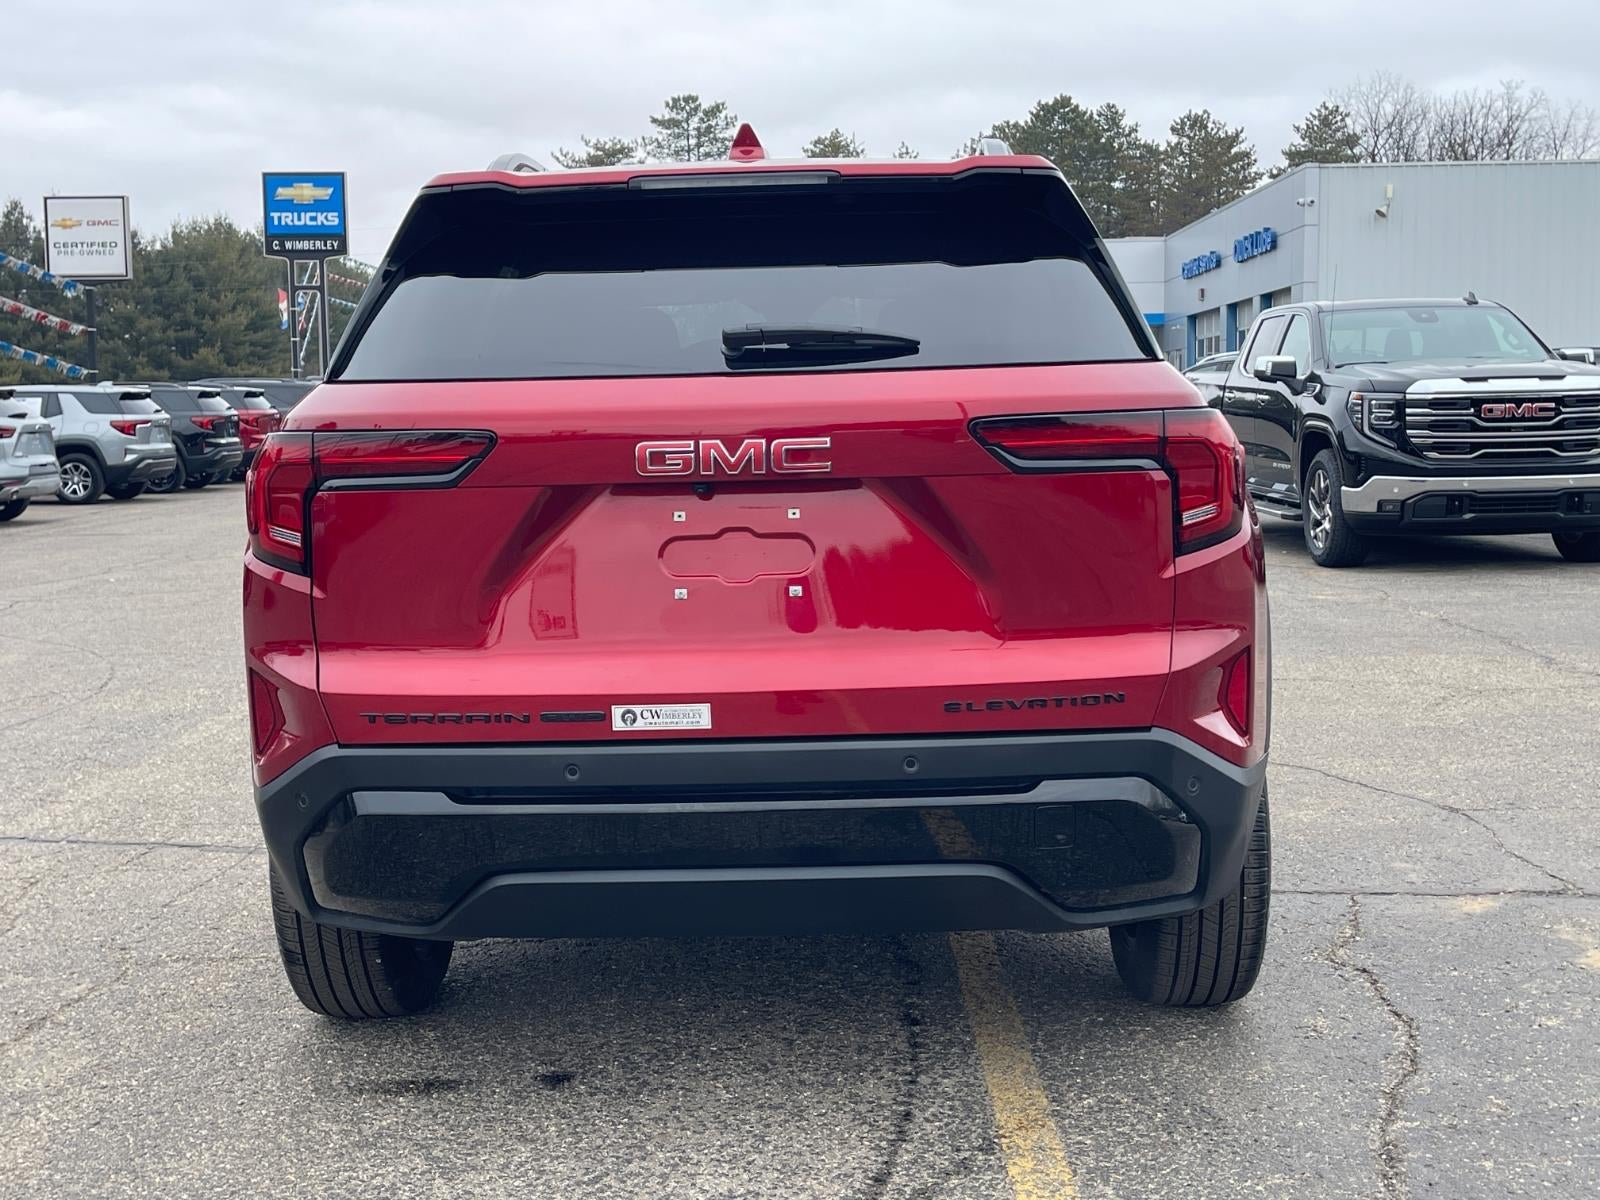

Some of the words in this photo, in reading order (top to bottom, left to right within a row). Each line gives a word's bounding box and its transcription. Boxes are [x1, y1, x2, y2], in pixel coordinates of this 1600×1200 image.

[86, 219, 119, 227] GMC
[270, 211, 339, 226] TRUCKS
[53, 241, 118, 249] CERTIFIED
[284, 240, 339, 250] WIMBERLEY
[1481, 402, 1556, 418] GMC
[635, 437, 832, 477] GMC
[943, 692, 1126, 713] ELEVATION
[360, 712, 531, 724] TERRAIN
